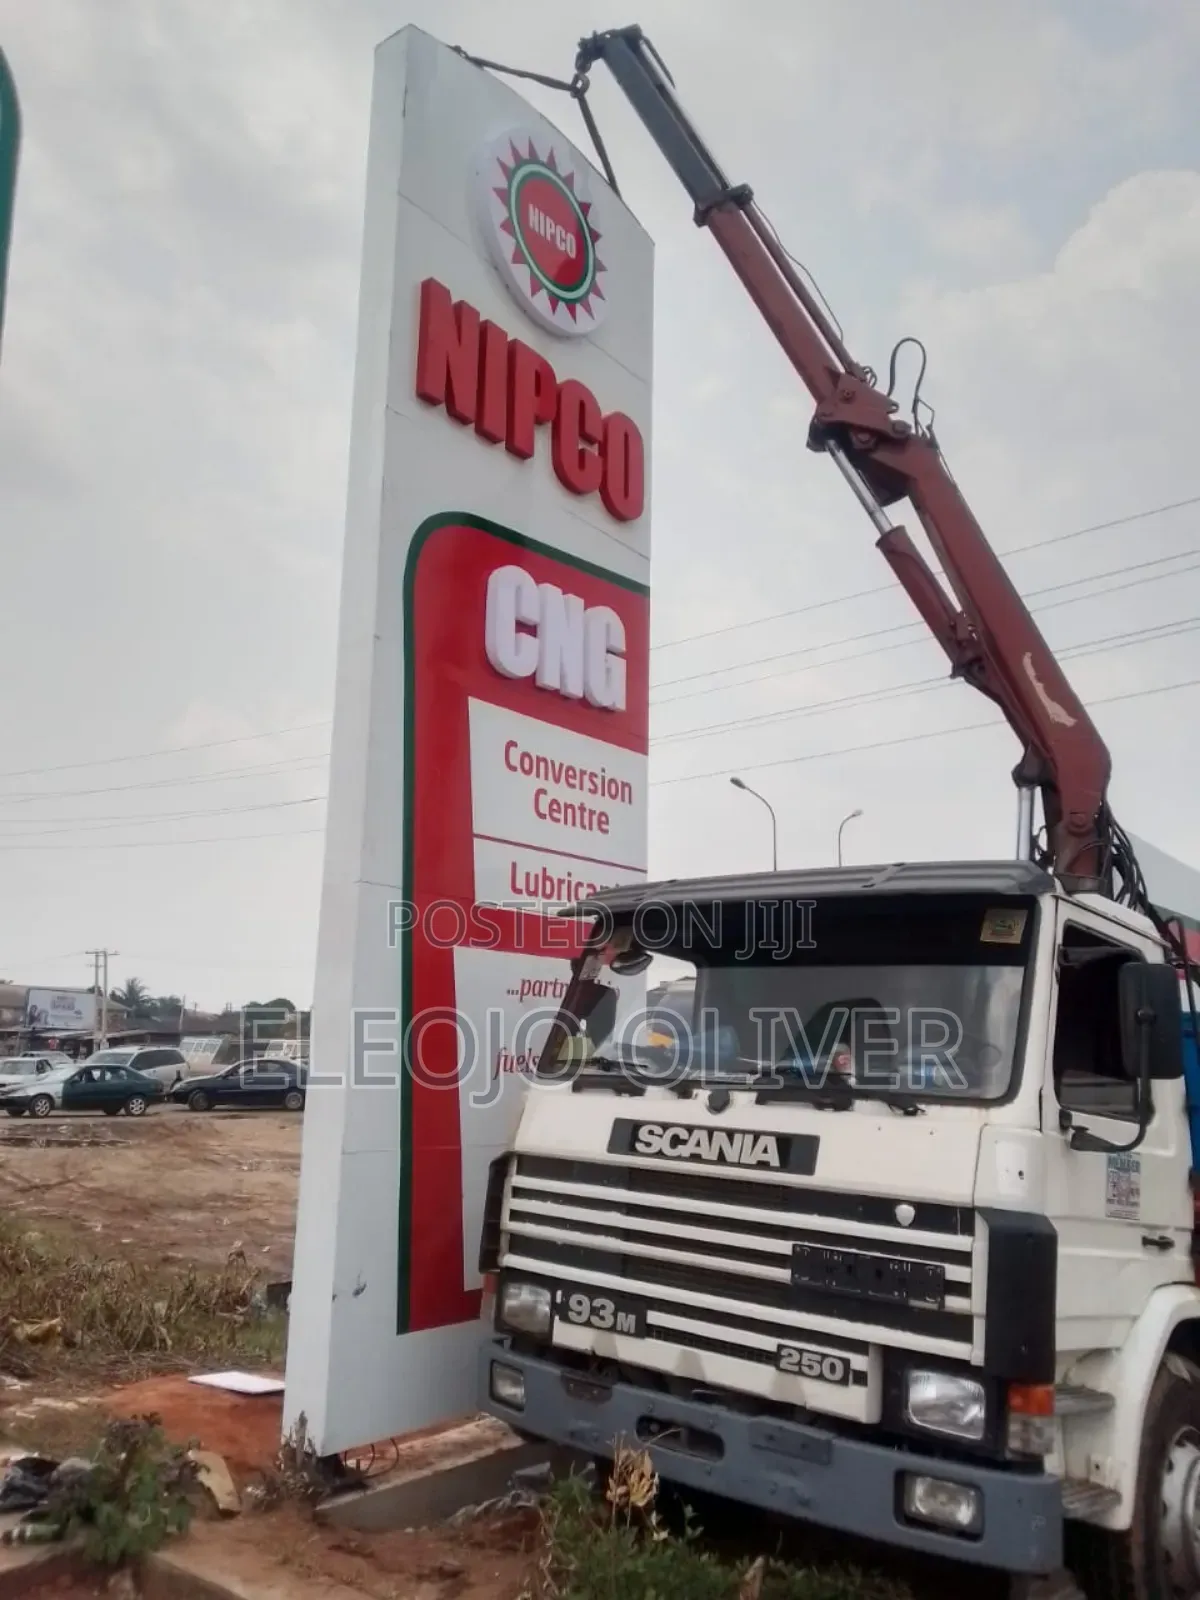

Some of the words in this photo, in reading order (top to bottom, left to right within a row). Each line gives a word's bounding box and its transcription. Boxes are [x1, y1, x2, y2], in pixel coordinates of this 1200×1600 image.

[528, 203, 576, 259] NIPCO
[416, 277, 644, 522] NIPCO
[485, 564, 626, 712] CNG
[504, 739, 633, 806] Conversion
[533, 787, 610, 835] Centre
[510, 861, 622, 903] Lubrica
[635, 1124, 781, 1168] SCANIA
[780, 1347, 844, 1381] 250
